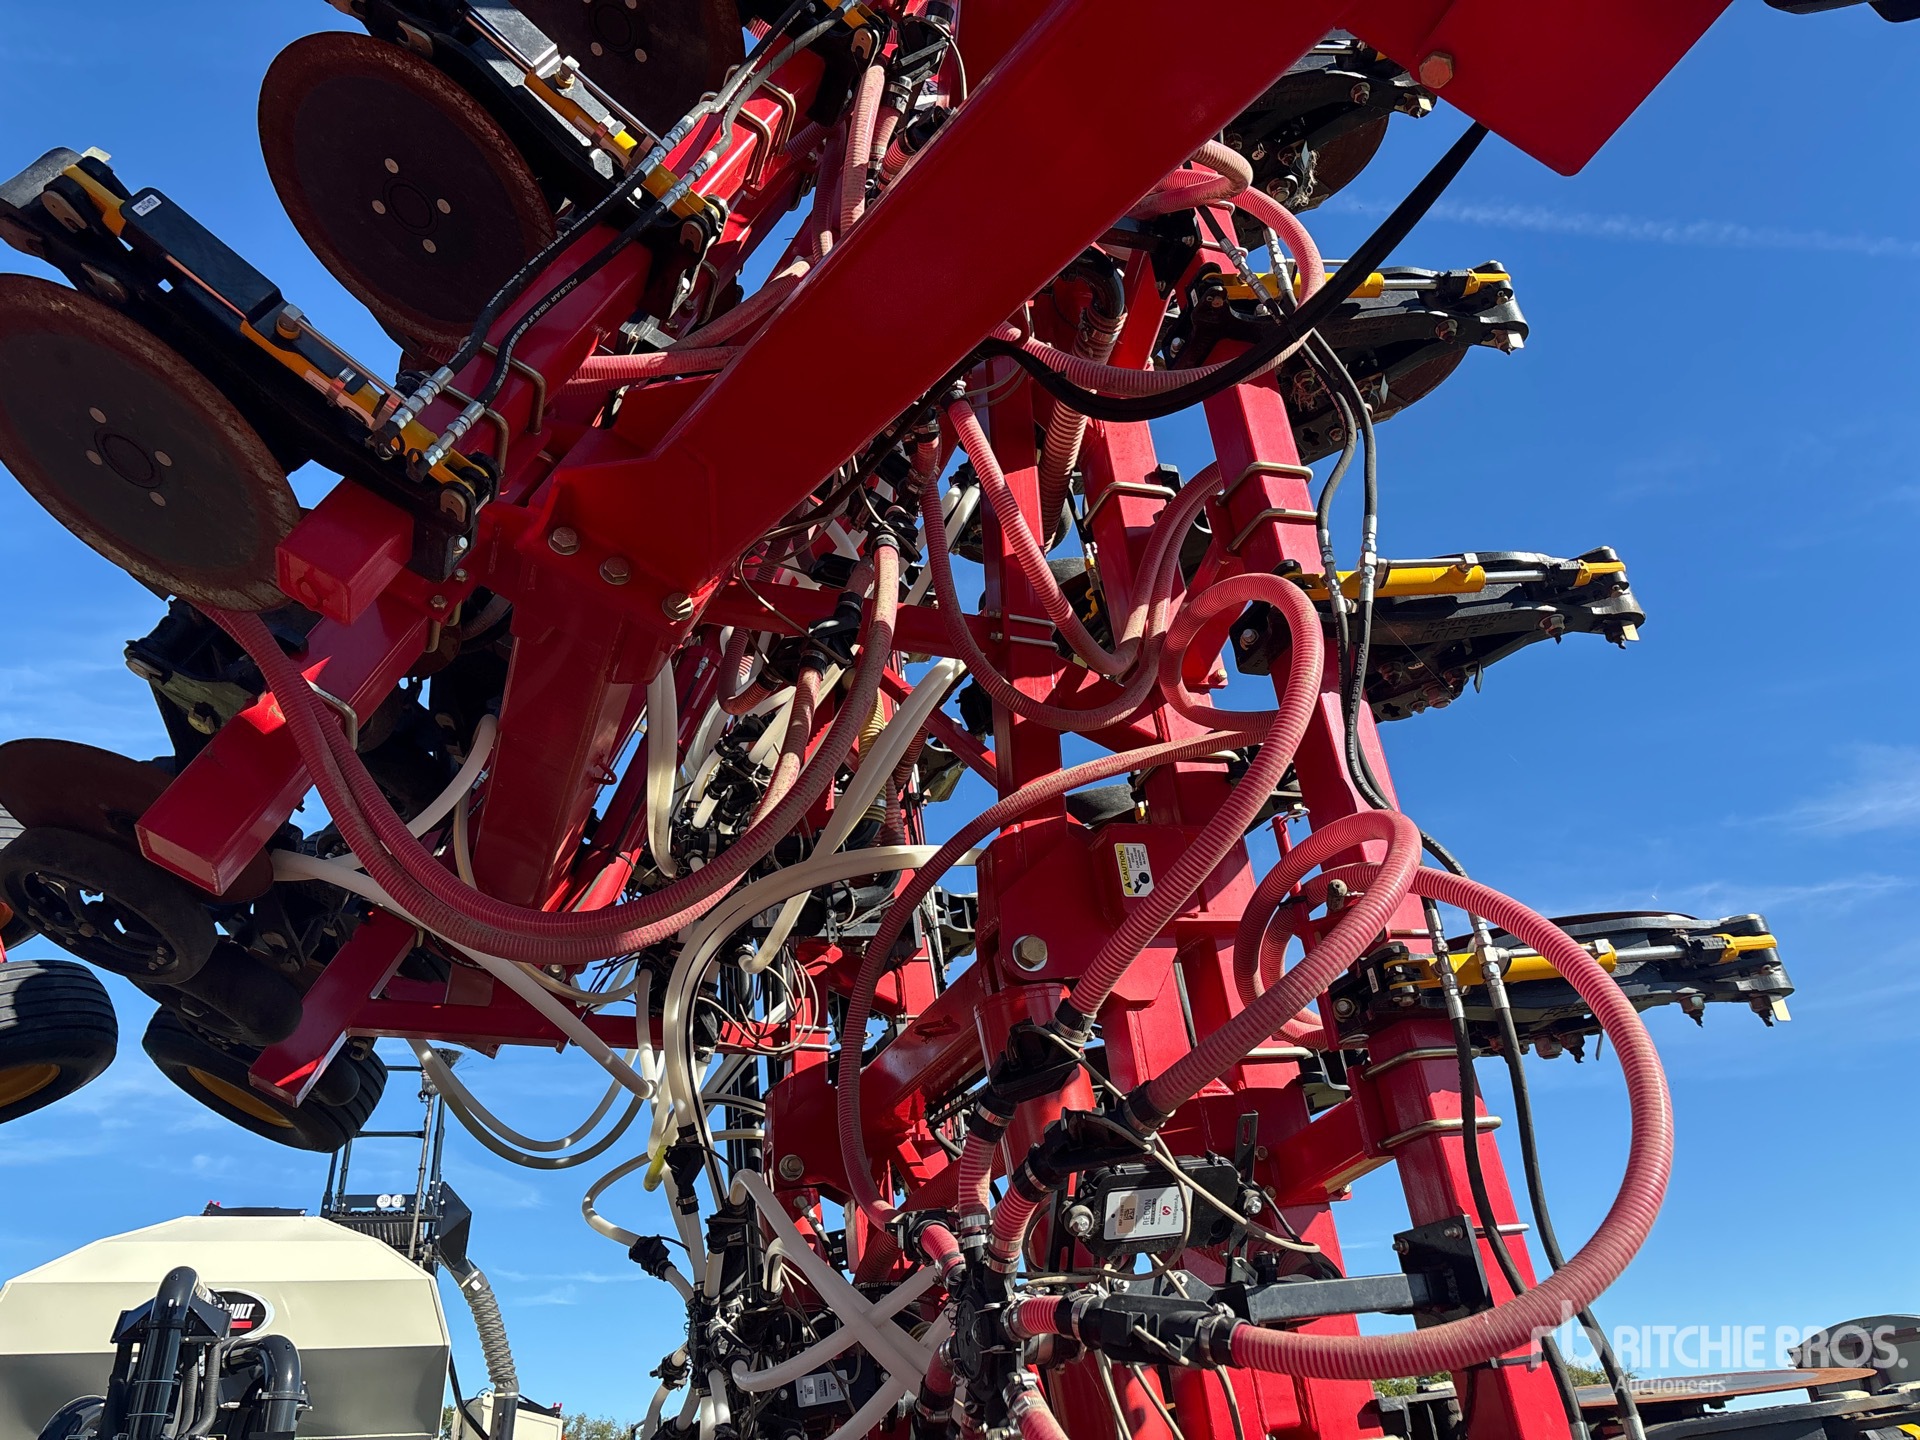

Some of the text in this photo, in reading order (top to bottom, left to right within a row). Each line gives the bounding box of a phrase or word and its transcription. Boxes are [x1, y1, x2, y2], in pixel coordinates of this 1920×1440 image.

[550, 277, 579, 303] PULSAR
[1354, 643, 1368, 676] PULSAR
[1118, 850, 1129, 881] CAUTION
[1143, 1199, 1152, 1225] RECON
